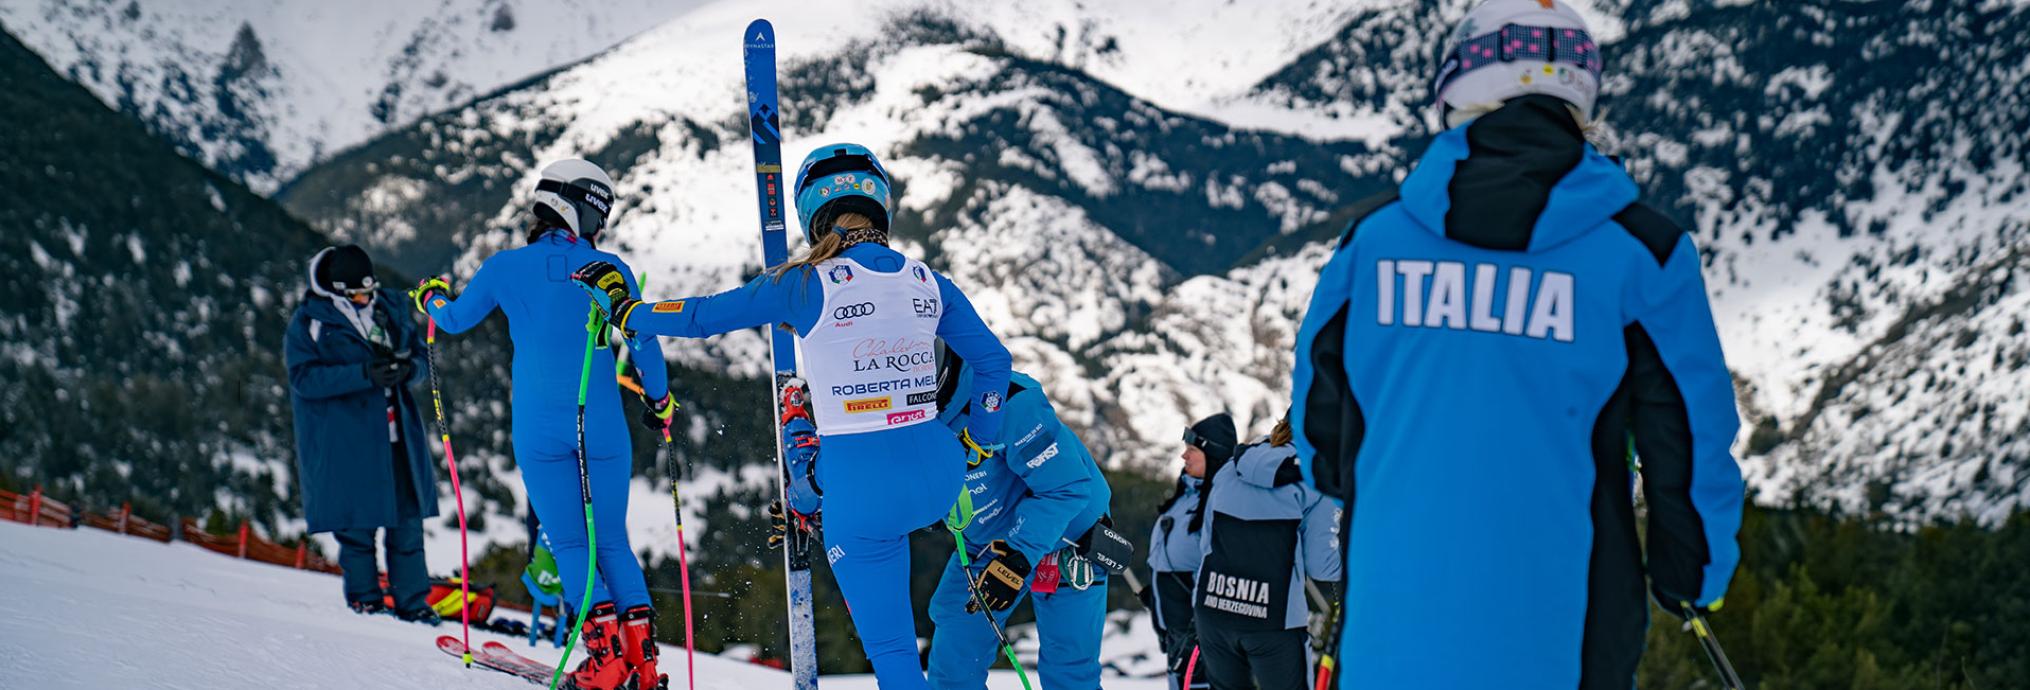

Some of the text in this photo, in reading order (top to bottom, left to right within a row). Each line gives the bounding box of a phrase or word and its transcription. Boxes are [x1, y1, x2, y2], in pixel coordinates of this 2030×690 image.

[590, 183, 609, 200] uvex
[585, 193, 609, 214] uvex
[912, 298, 937, 315] EA7
[1377, 259, 1575, 343] ITALIA
[835, 320, 853, 328] Audi
[853, 358, 881, 372] LA
[831, 378, 911, 396] ROBERTA
[997, 566, 1021, 585] LEVEL
[1206, 571, 1269, 604] BOSNIA
